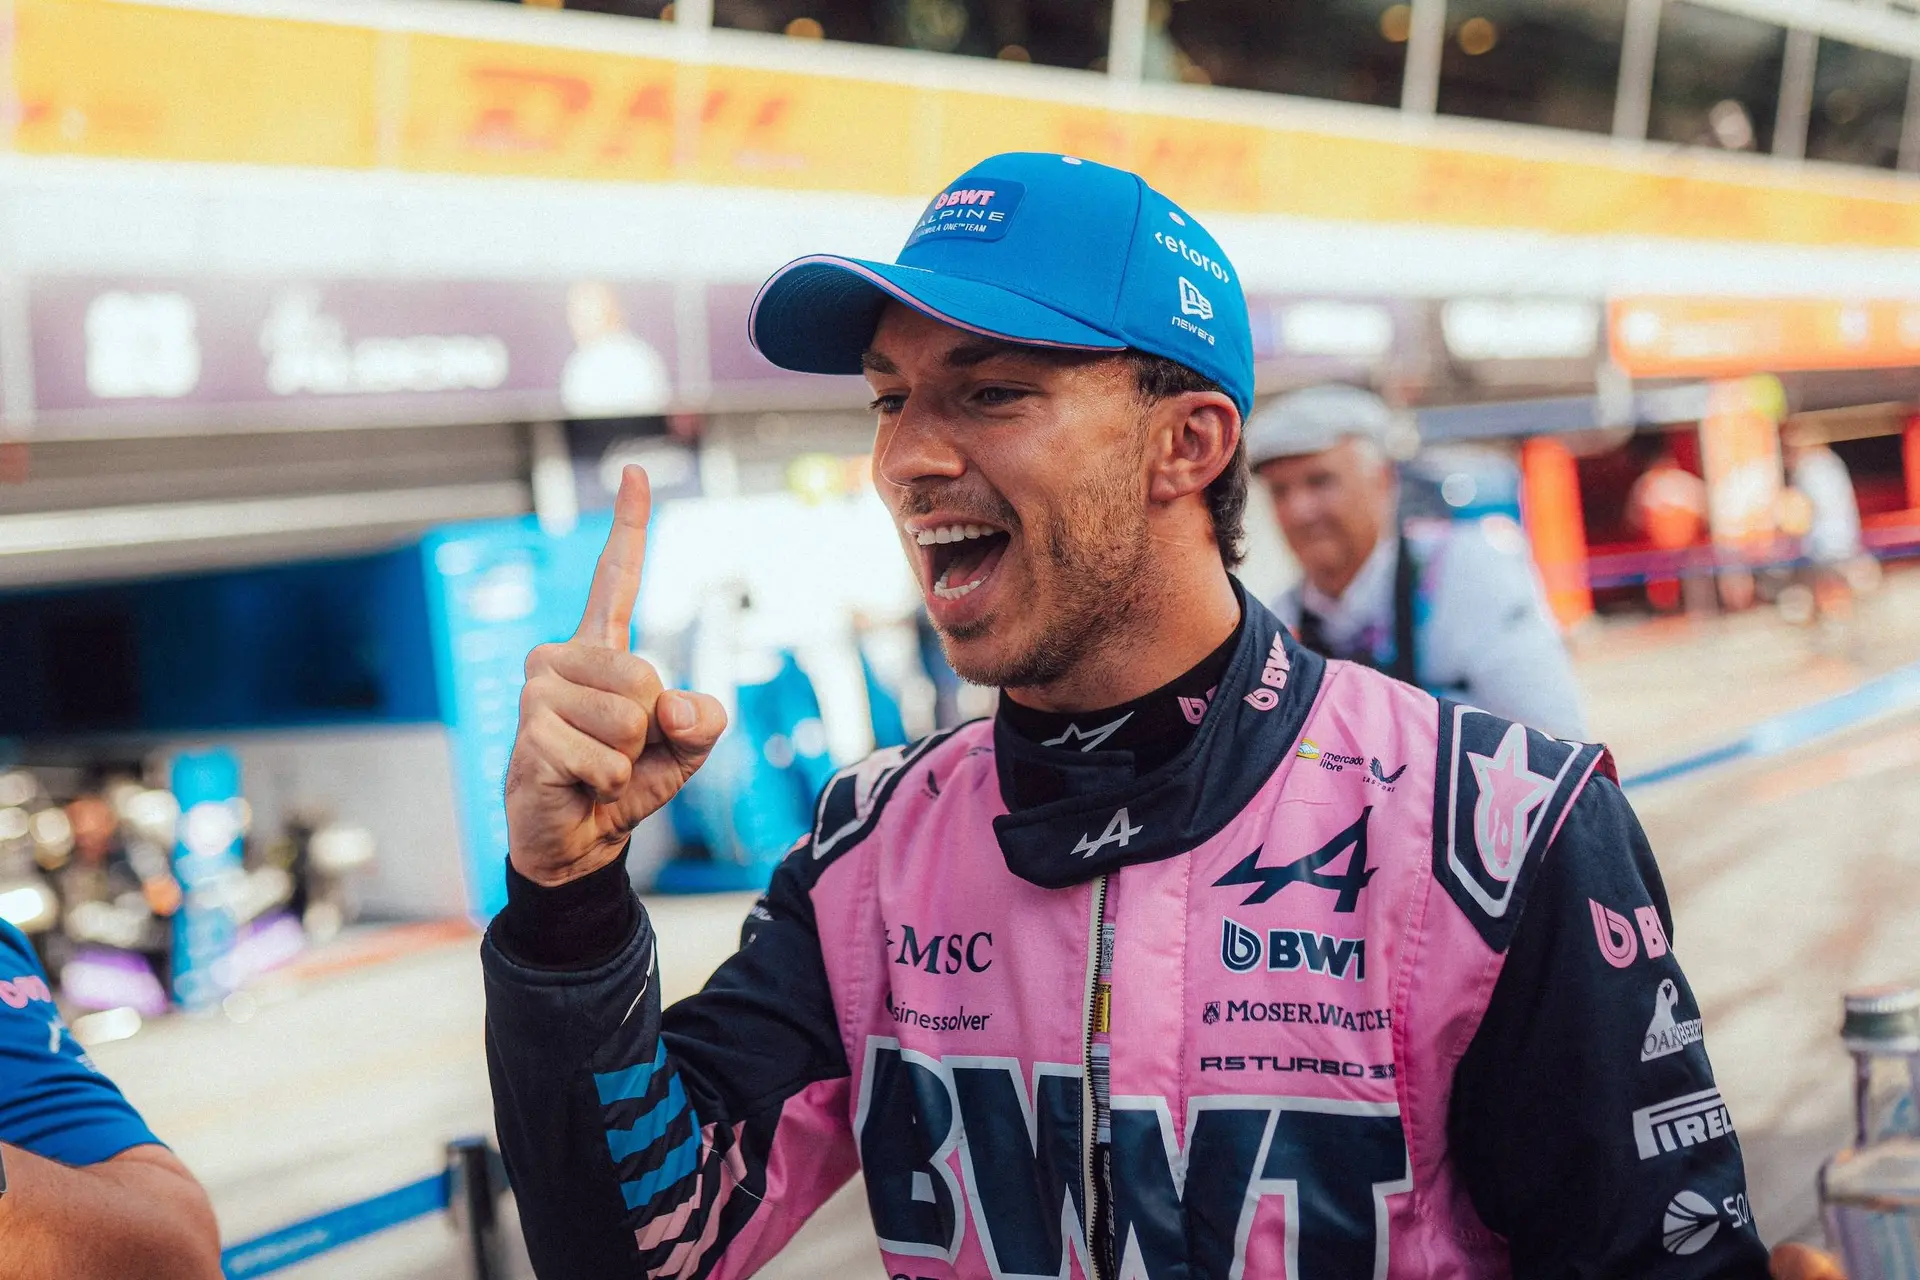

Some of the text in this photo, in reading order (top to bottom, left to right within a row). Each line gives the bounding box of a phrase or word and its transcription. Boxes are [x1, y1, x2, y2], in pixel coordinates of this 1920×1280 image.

[1319, 758, 1343, 772] libre
[1323, 751, 1364, 766] mercado
[894, 924, 993, 975] MSC
[850, 1034, 1414, 1280] BWT
